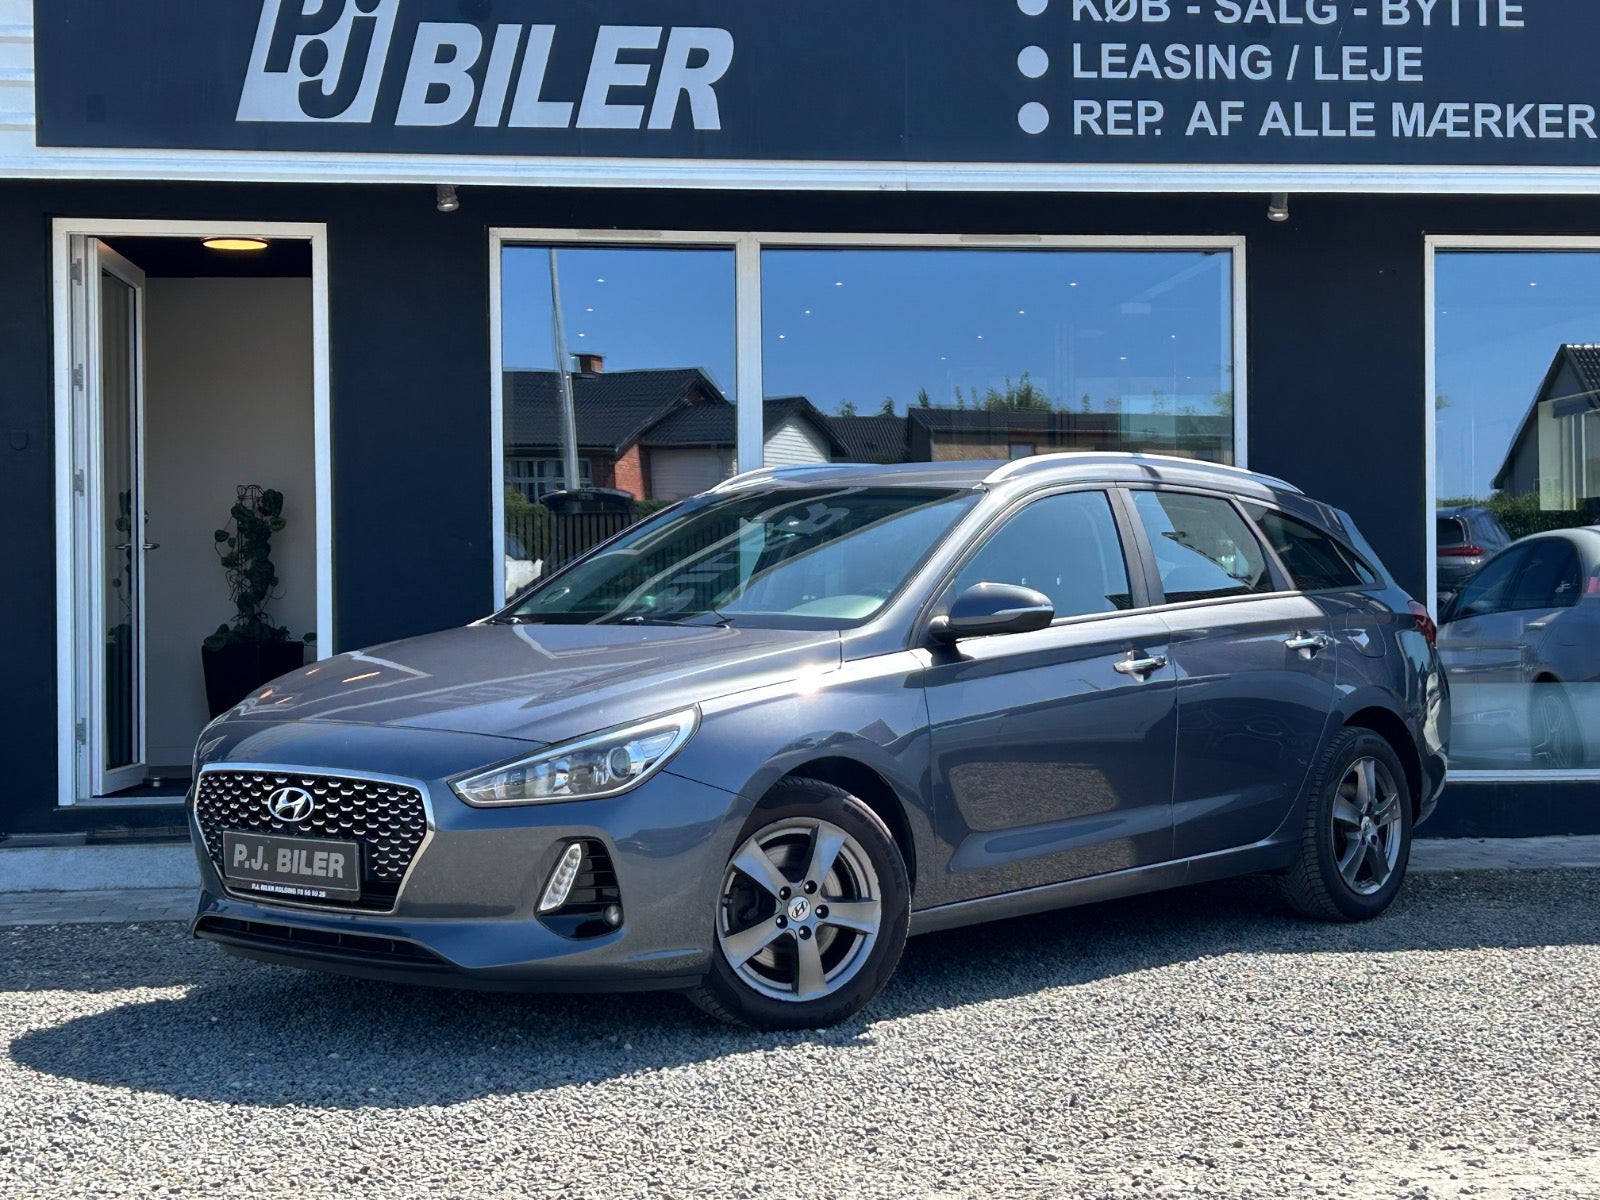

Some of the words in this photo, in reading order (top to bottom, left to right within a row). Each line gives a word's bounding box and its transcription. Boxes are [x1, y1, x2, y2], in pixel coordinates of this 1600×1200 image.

[1072, 0, 1171, 23] KØB
[1214, 0, 1338, 25] SALG
[1381, 0, 1525, 27] BYTTE
[395, 22, 735, 130] BILER
[1073, 43, 1272, 80] LEASING
[1286, 45, 1300, 81] /
[1314, 46, 1424, 82] LEJE
[1073, 100, 1164, 136] REP.
[1185, 101, 1245, 136] AF
[1258, 101, 1376, 137] ALLE
[1391, 103, 1598, 139] MÆRKER
[233, 843, 269, 871] P.J.
[276, 847, 345, 879] BILER
